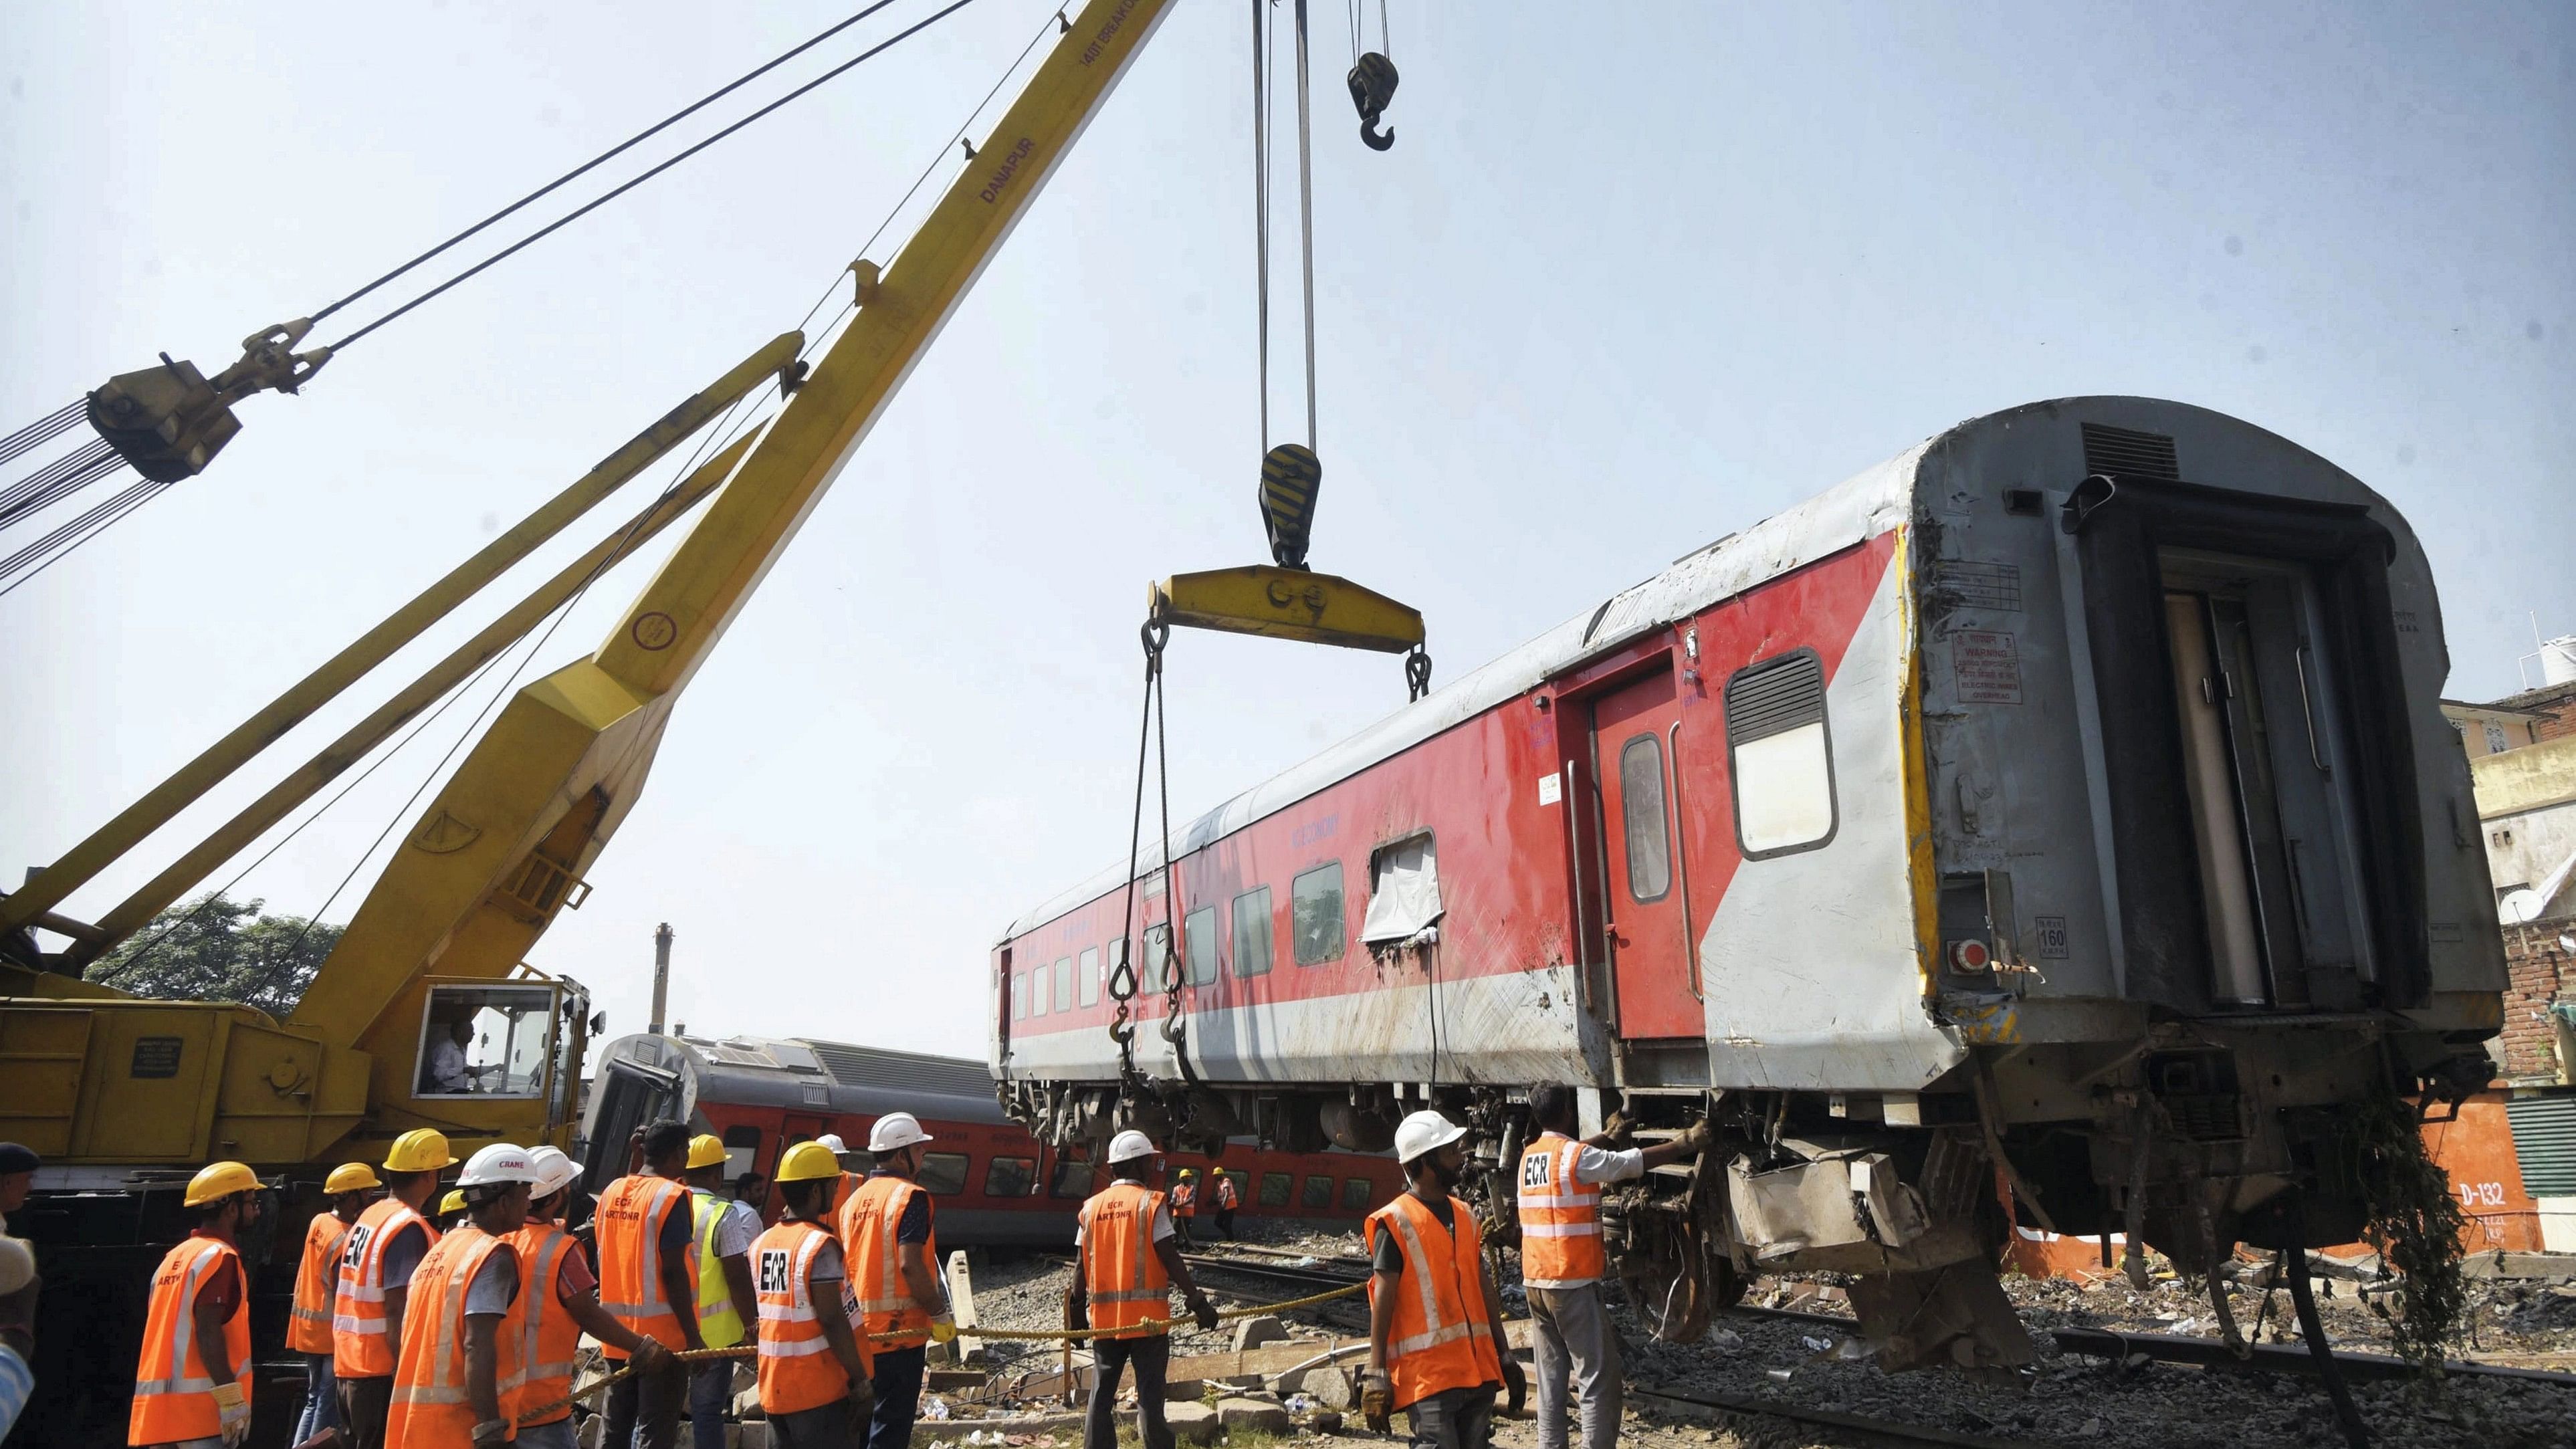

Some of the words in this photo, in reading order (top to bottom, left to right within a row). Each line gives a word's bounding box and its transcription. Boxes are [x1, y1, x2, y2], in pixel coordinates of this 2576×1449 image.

[1097, 0, 1140, 43] BREAKD
[979, 137, 1035, 204] DANAPUR
[1965, 648, 2007, 659] WARNING
[1961, 682, 1996, 690] ELECTRIC
[1973, 692, 2010, 700] OVERHEAD
[2040, 929, 2064, 947] 160
[499, 1160, 524, 1169] CRANE
[1525, 1154, 1548, 1186] ECR
[2459, 1182, 2506, 1206] D-132
[760, 1252, 787, 1291] ECR
